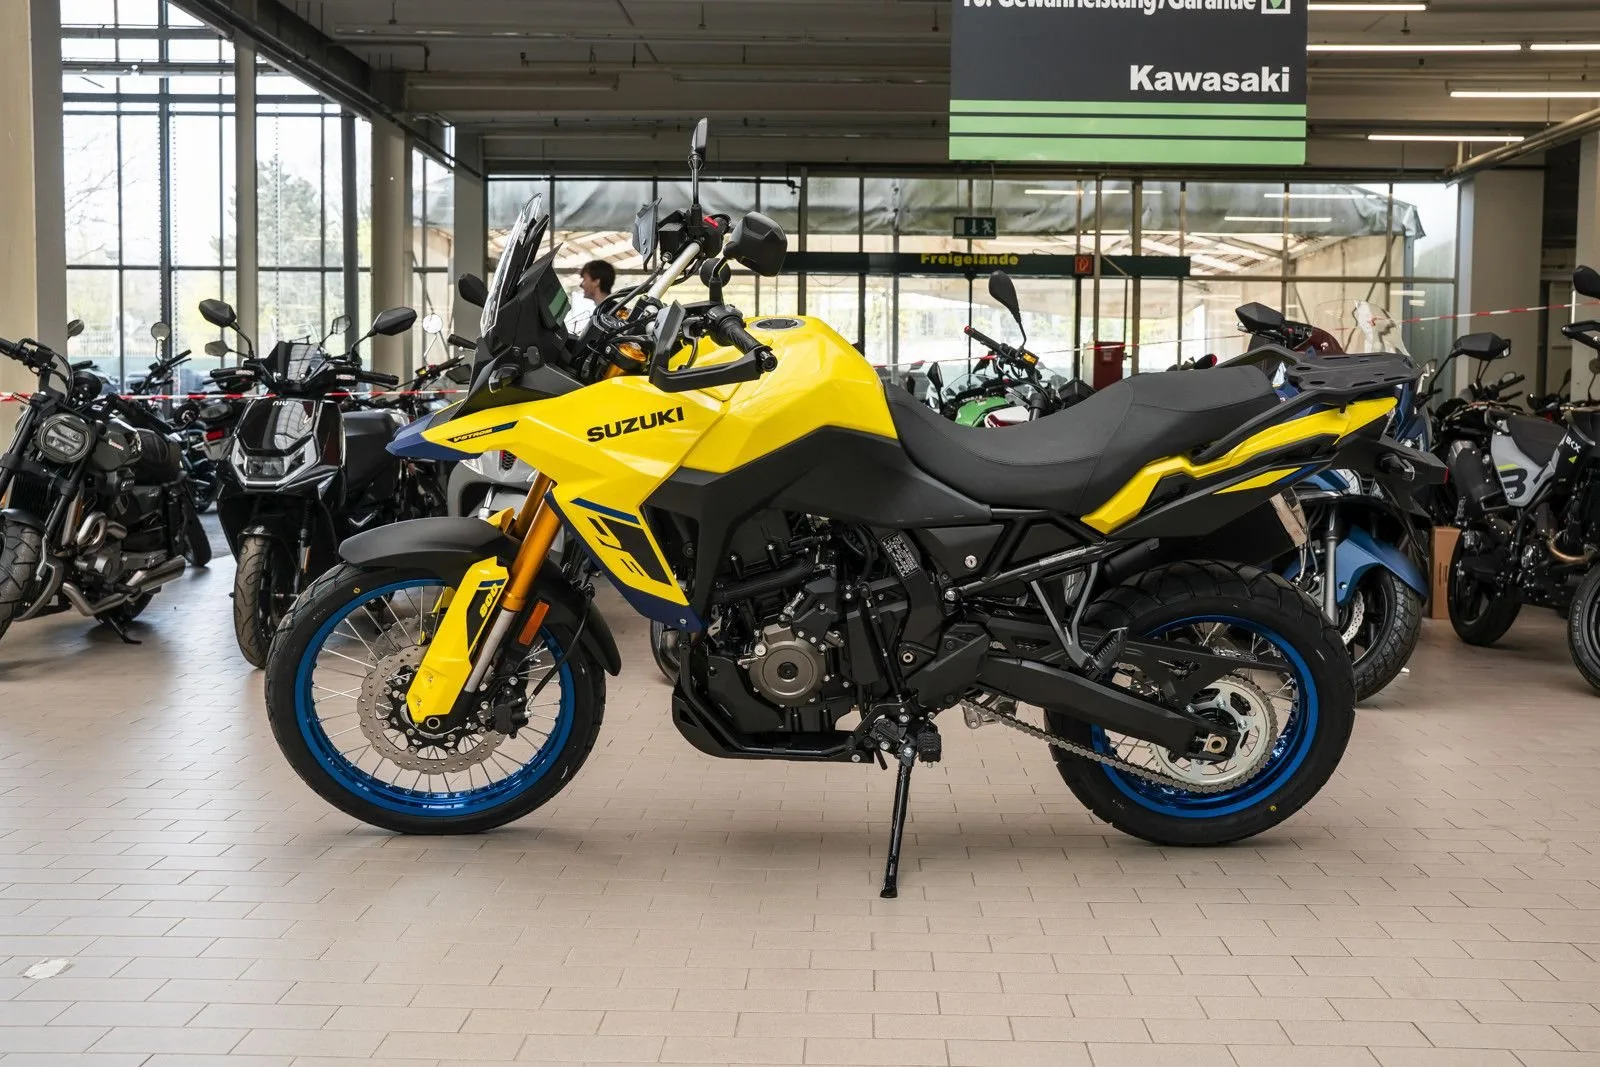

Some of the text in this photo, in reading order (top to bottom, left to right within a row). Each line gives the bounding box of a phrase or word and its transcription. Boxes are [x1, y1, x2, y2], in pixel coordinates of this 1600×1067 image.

[1129, 65, 1290, 93] Kawasaki
[920, 252, 1019, 267] Freigelände
[586, 406, 684, 443] SUZUKI
